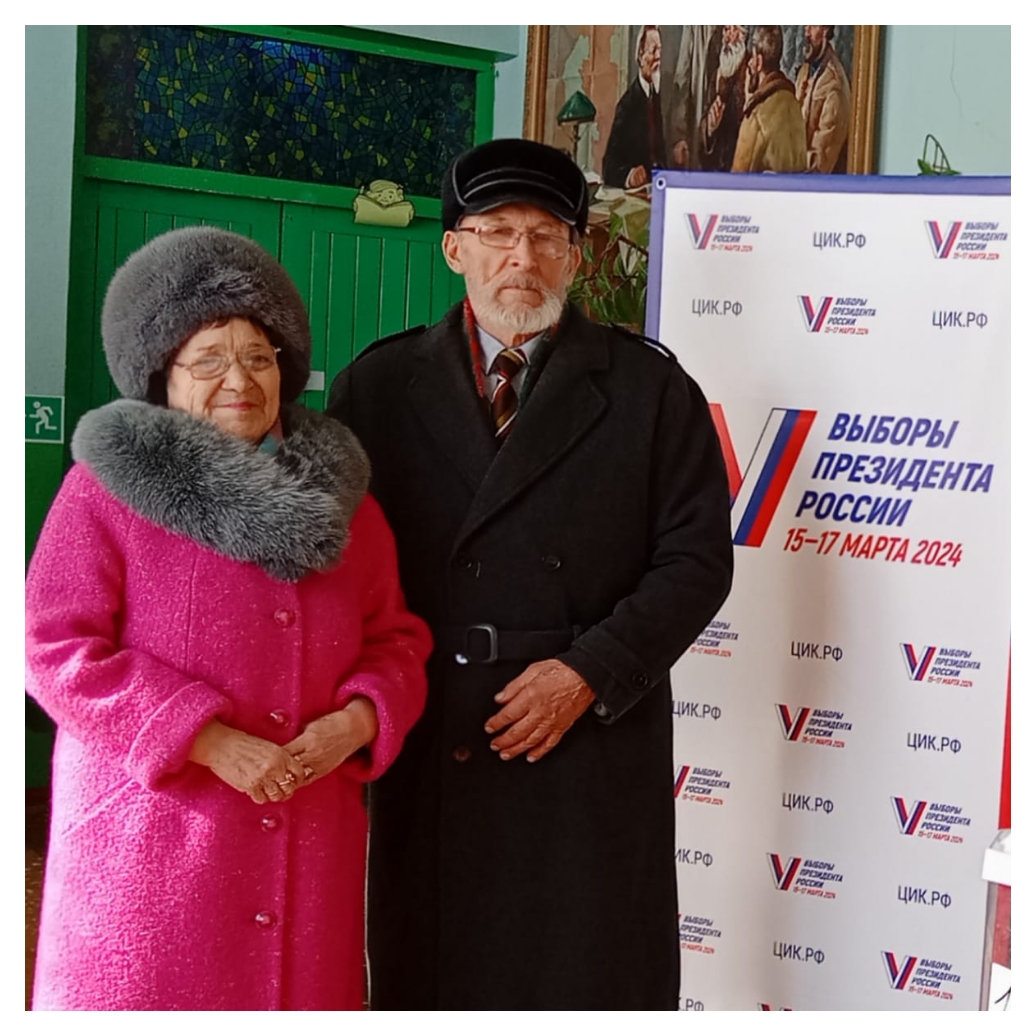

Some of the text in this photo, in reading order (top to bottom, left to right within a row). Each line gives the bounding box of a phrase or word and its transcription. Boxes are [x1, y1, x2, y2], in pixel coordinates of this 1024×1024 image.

[813, 232, 867, 250] ЦИК.РФ
[692, 299, 743, 317] ЦИК.РФ
[932, 310, 988, 329] ЦИК.РФ
[827, 412, 960, 450] ВЫБОРЫ
[811, 452, 995, 493] ПРЕЗИДЕНТА
[795, 490, 913, 527] РОССИИ
[838, 532, 910, 563] МАРТА
[910, 539, 963, 568] 2024
[791, 641, 843, 661] ЦИК.РФ
[907, 732, 962, 753] ЦИК.РФ
[782, 792, 834, 814] ЦИК.РФ
[898, 885, 952, 908] ЦИК.РФ
[773, 942, 825, 964] ЦИК.РФ
